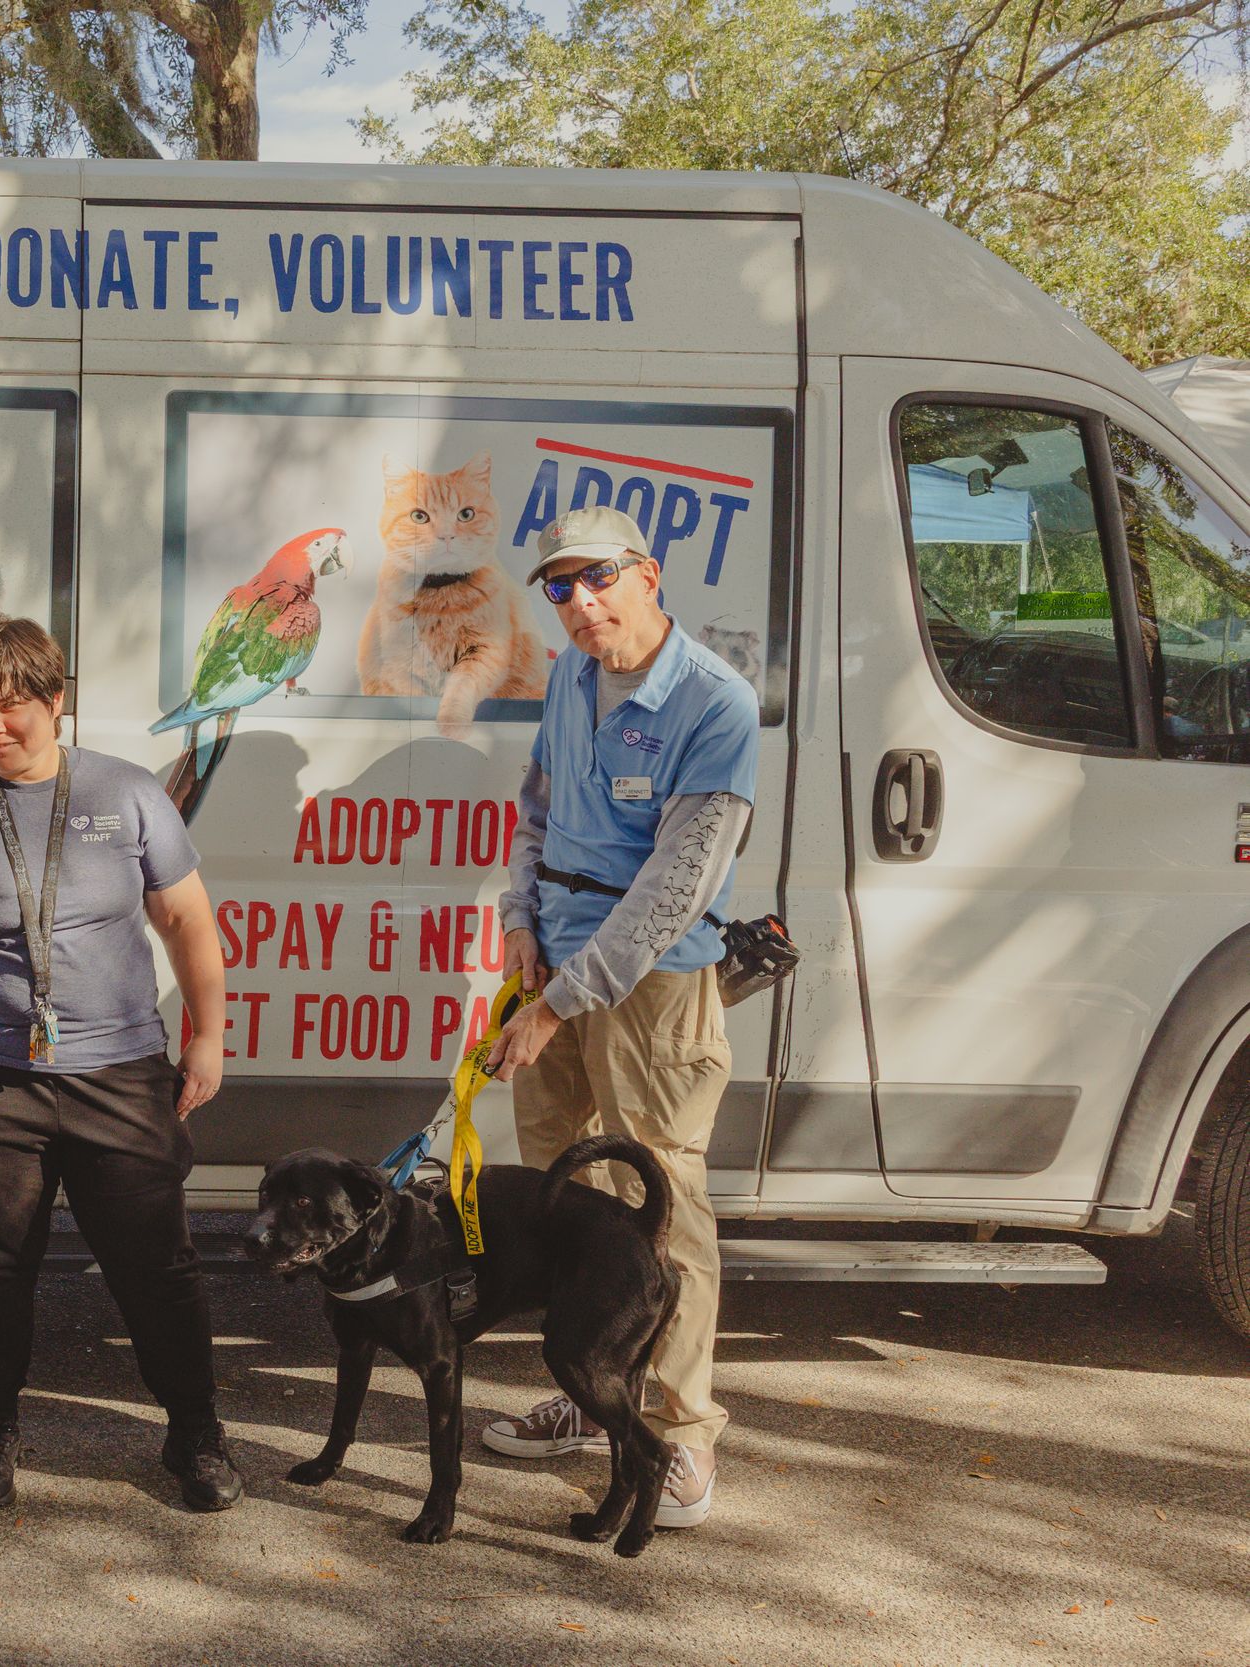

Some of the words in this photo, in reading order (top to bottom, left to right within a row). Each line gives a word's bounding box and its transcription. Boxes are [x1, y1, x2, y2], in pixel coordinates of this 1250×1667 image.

[269, 233, 634, 322] VOLUNTEER
[512, 459, 750, 587] ADOPT
[81, 833, 111, 842] STAFF
[216, 900, 344, 971] SPAY
[368, 900, 400, 972] &
[419, 904, 505, 973] NEU
[181, 992, 270, 1059] ET
[291, 993, 411, 1062] FOOD
[465, 1198, 475, 1216] ME
[466, 1216, 480, 1252] ADOPT
